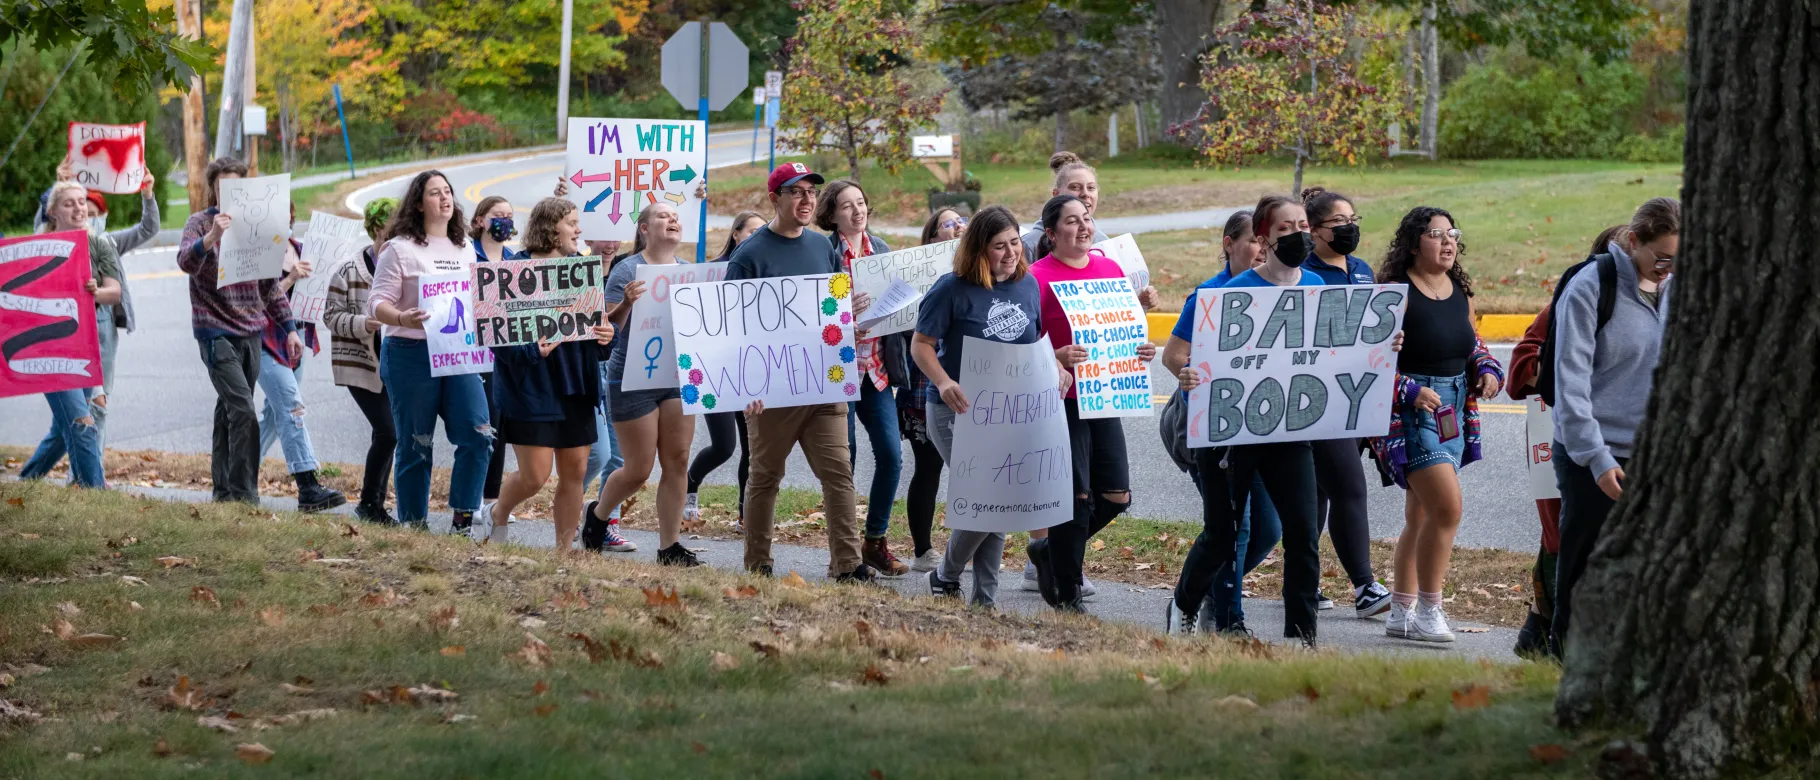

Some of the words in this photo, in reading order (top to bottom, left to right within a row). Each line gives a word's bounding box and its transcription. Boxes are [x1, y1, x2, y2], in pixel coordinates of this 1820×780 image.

[81, 127, 126, 140] DON'T
[588, 122, 622, 155] I'M
[636, 124, 695, 152] WITH
[77, 170, 99, 185] ON
[614, 158, 669, 191] HER
[307, 277, 326, 296] CA
[423, 281, 458, 299] RESPECT
[462, 280, 471, 292] M
[476, 260, 601, 301] PROTECT
[1053, 280, 1132, 297] PRO-CHOICE
[14, 298, 46, 312] SHE
[291, 291, 326, 321] BLEE
[674, 277, 829, 337] SUPPORT
[1061, 295, 1137, 311] PRO-CHOICE
[640, 316, 662, 331] ARE
[1069, 310, 1136, 327] PRO-CHOICE
[1218, 287, 1404, 351] BANS
[476, 311, 602, 346] FREEDOM
[1074, 325, 1145, 344] PRO-CHOICE
[432, 352, 469, 368] EXPECT
[471, 350, 485, 364] MY
[1086, 342, 1145, 360] O-CHOIC
[1230, 353, 1268, 370] OFF
[1291, 350, 1320, 365] MY
[22, 359, 74, 373] PERSISTED
[695, 343, 825, 398] WOMEN
[1005, 360, 1032, 379] are
[1077, 358, 1146, 378] PRO-CHOICE
[1079, 375, 1149, 394] PRO-CHOICE
[972, 387, 1061, 426] GENERATIO
[1081, 393, 1151, 411] PRO-CHOICE
[1208, 372, 1379, 442] BODY
[956, 455, 978, 478] of
[992, 446, 1069, 485] ACTION
